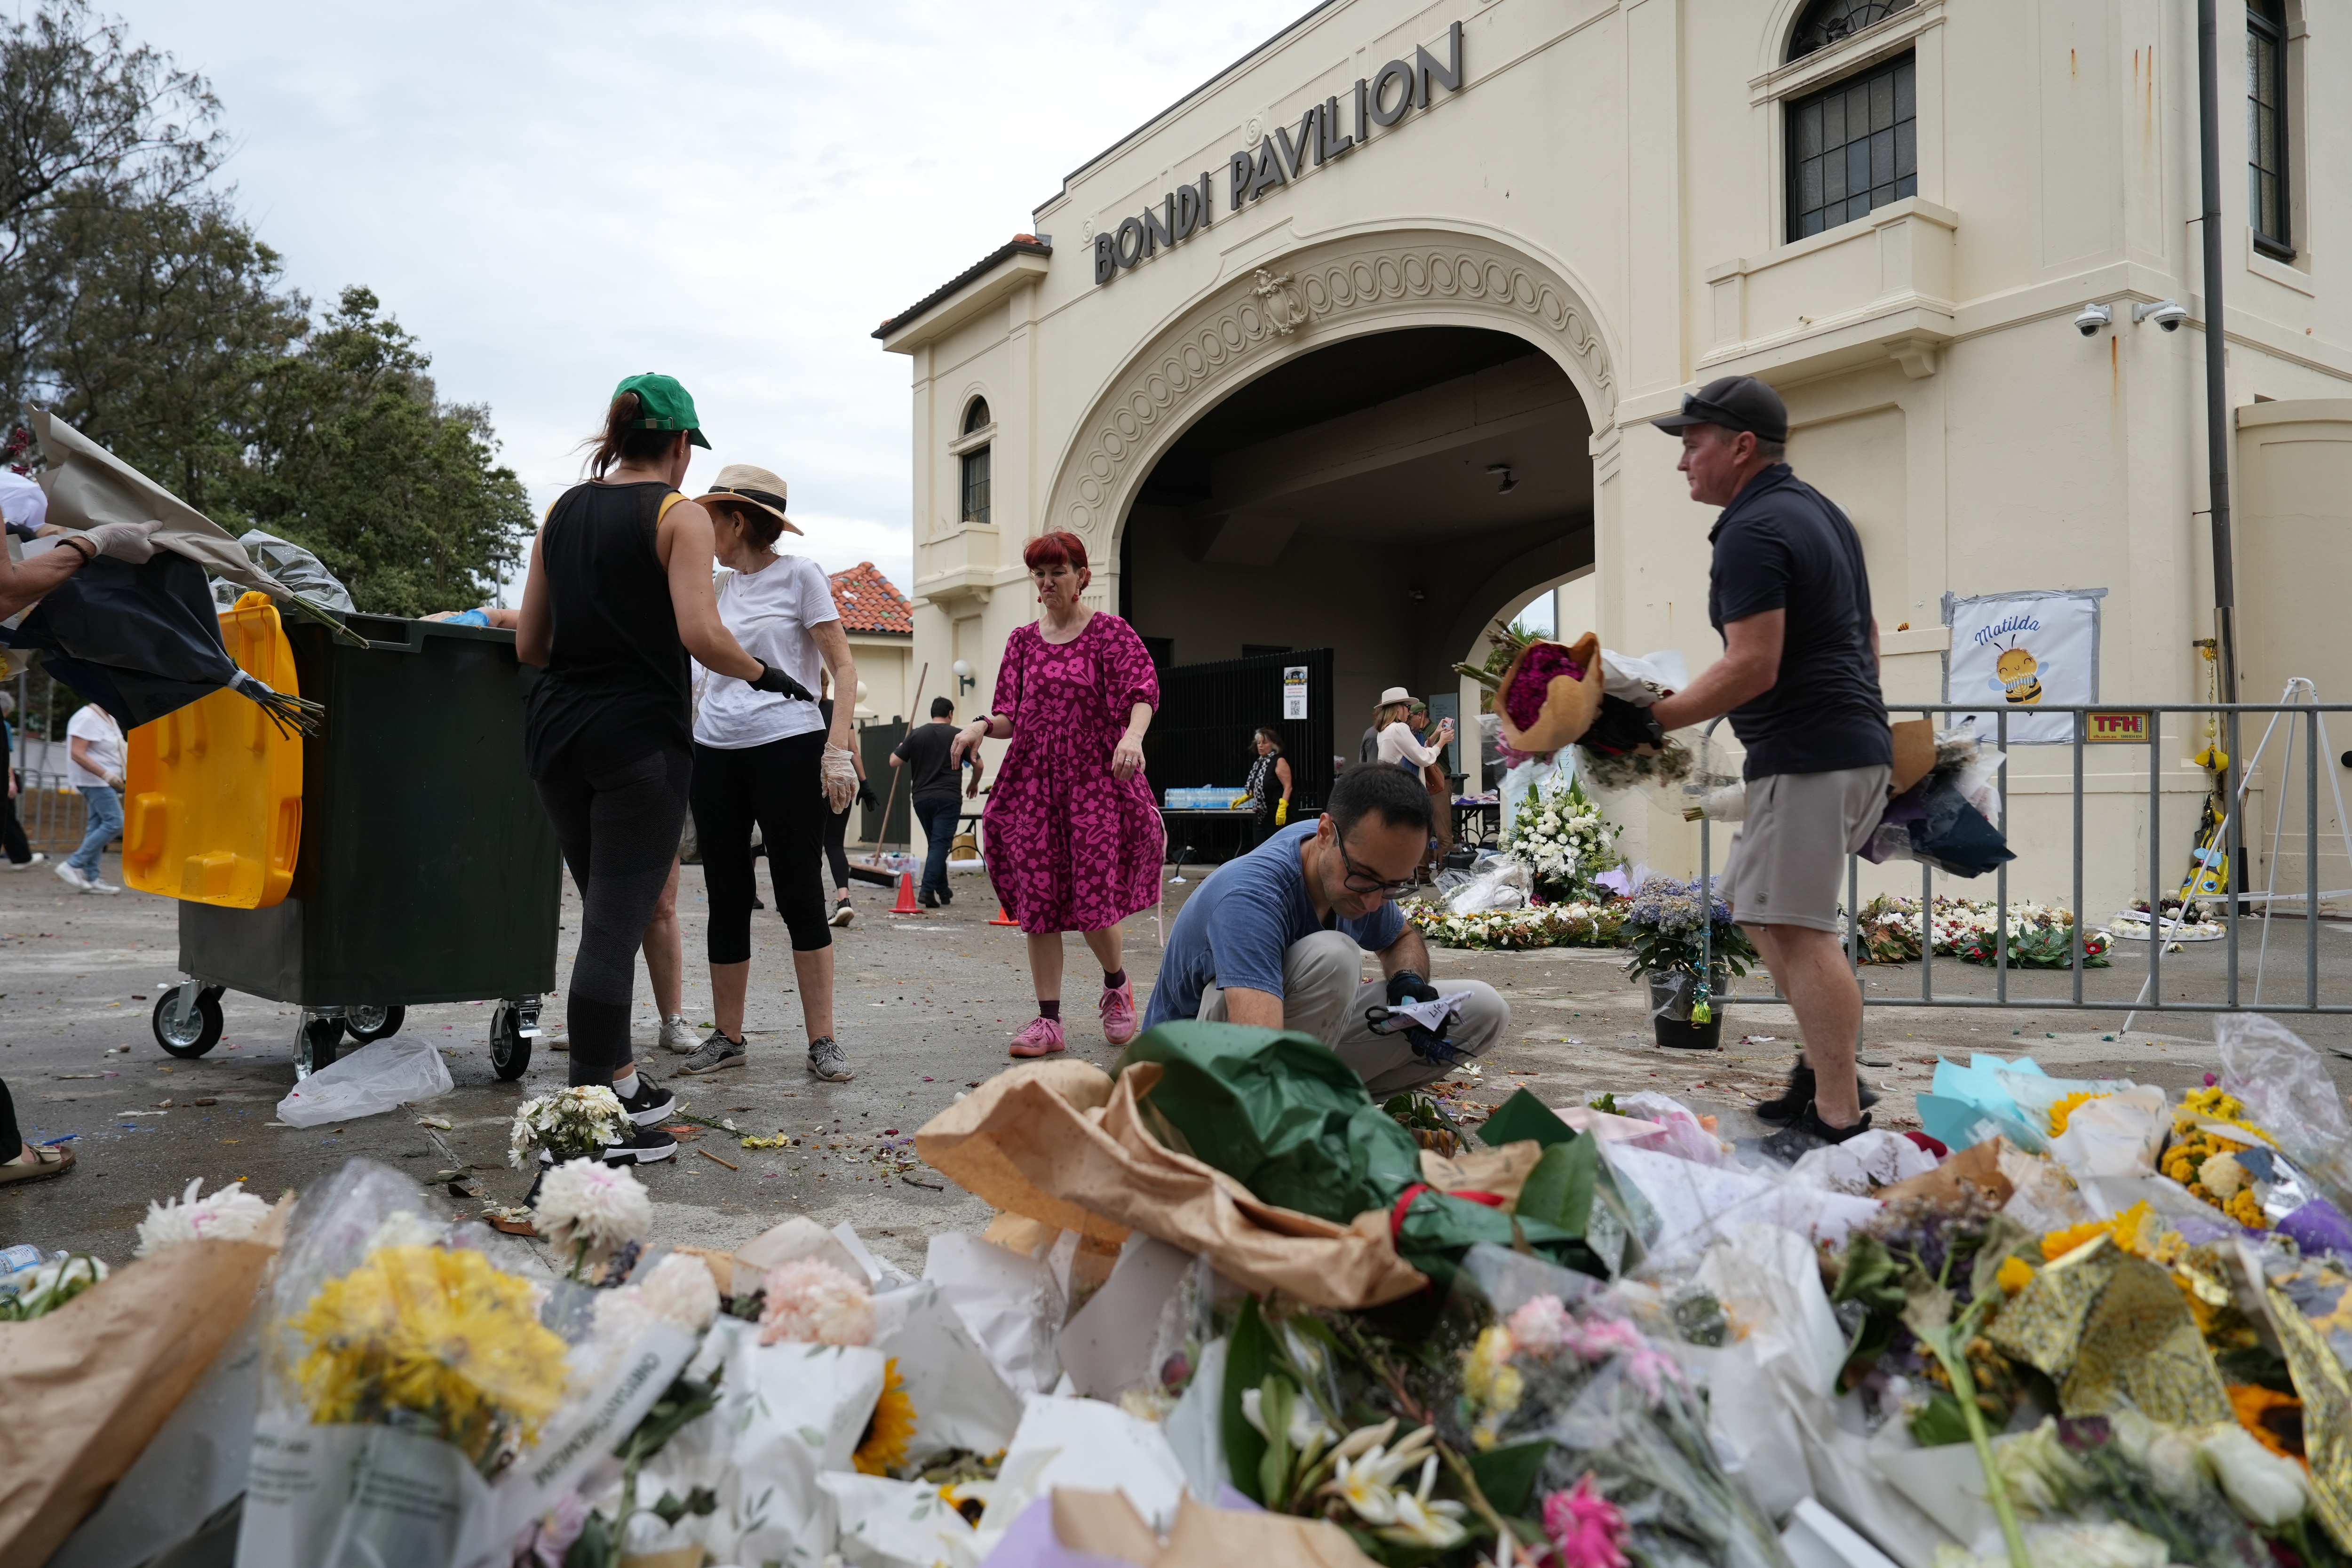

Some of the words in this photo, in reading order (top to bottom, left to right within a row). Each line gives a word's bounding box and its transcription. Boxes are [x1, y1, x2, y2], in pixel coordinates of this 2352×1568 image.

[1095, 171, 1212, 286] BONDI
[1230, 20, 1463, 211] PAVILION
[1975, 615, 2041, 646] Matilda
[2094, 716, 2137, 732] TFH
